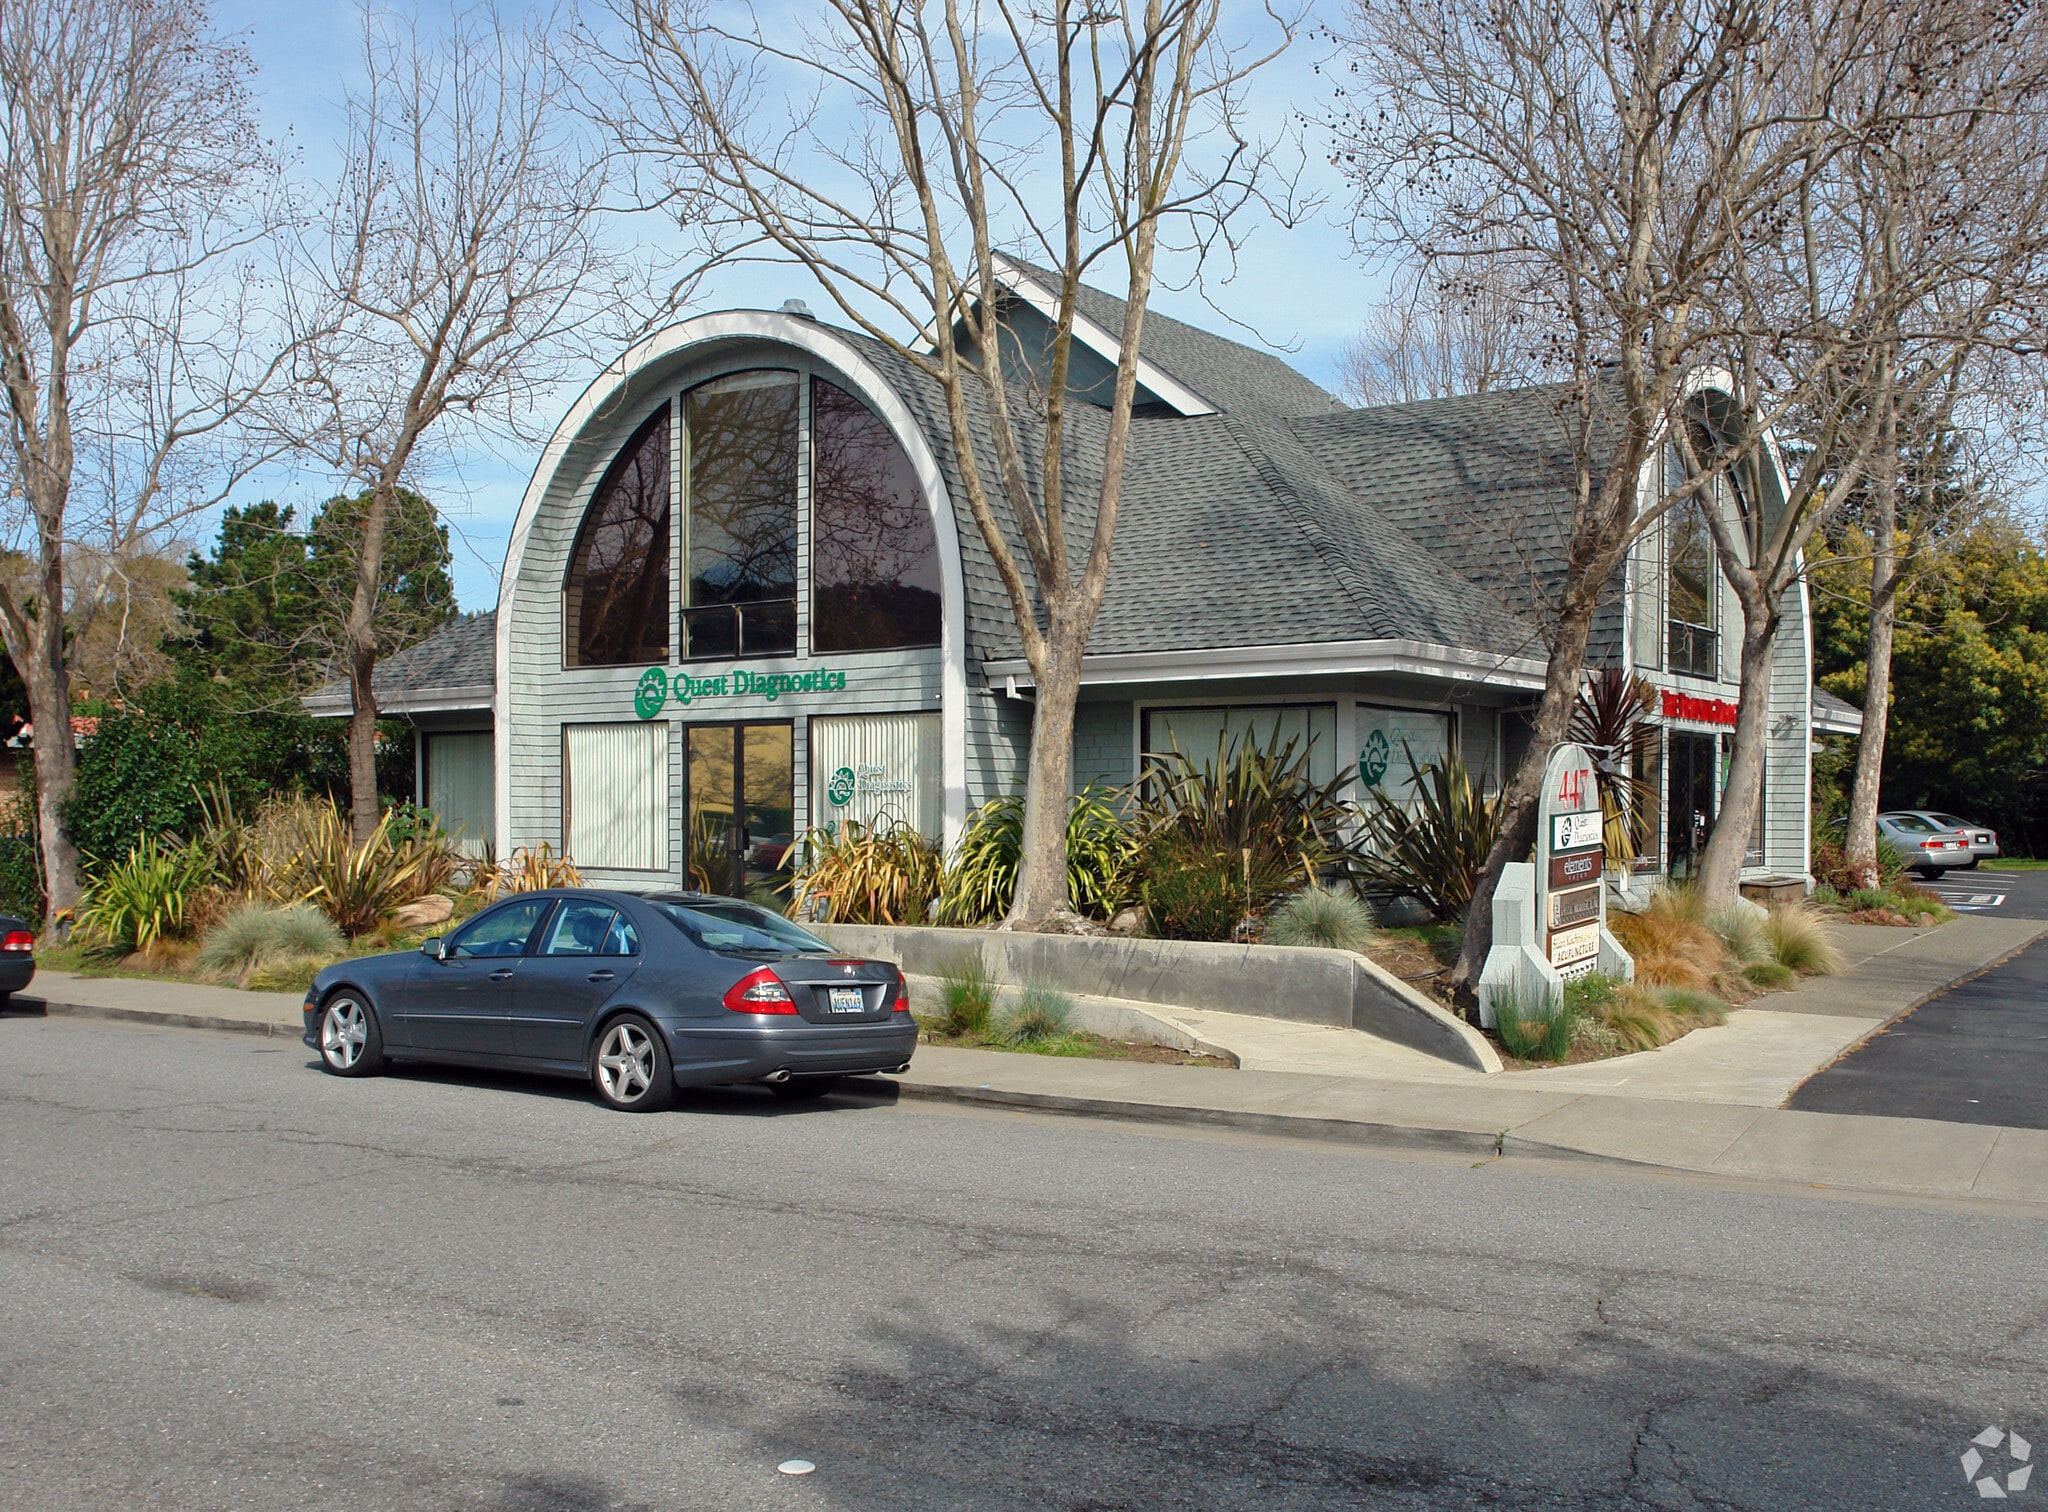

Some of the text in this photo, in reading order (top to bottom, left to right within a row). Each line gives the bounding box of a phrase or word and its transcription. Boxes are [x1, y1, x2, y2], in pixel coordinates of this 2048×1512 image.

[673, 667, 846, 705] Quest Diagnostics
[857, 763, 886, 779] Quest
[858, 779, 912, 795] Diagnostics
[1558, 769, 1590, 811] 447
[1563, 857, 1592, 875] elements
[1557, 941, 1595, 962] ACUPUNCTURE
